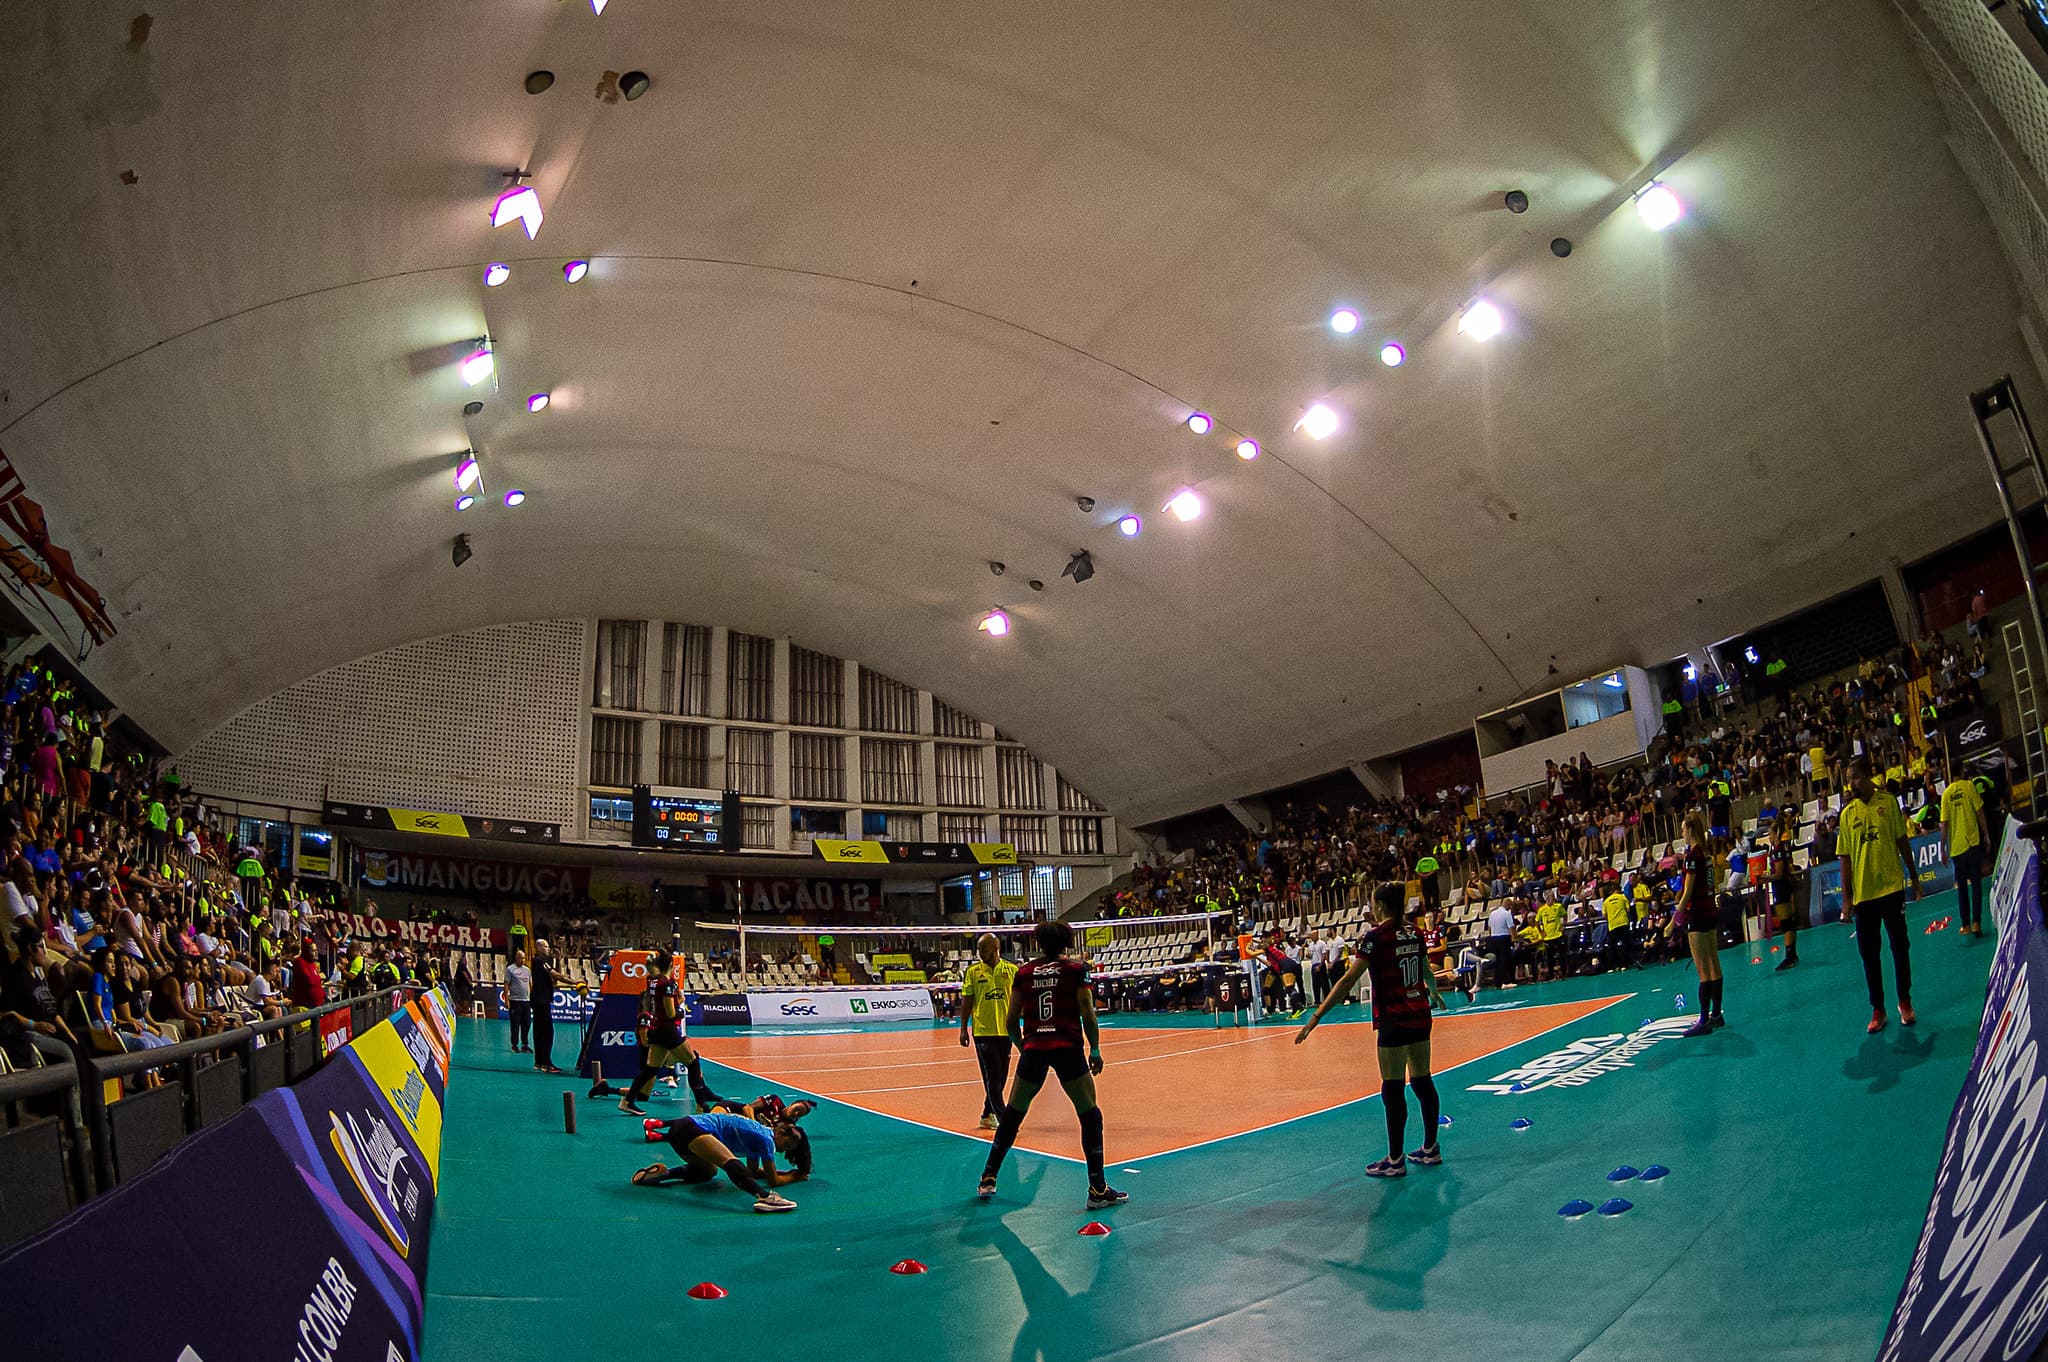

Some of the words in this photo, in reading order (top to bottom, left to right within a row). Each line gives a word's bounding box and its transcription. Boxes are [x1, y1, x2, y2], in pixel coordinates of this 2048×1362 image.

[1959, 719, 1987, 745] Sesc
[415, 814, 440, 829] Sesc
[674, 811, 699, 822] 00:00
[656, 829, 669, 839] 00
[705, 832, 718, 842] 00
[839, 845, 863, 858] Sesc
[992, 848, 1013, 860] Sesc
[721, 878, 835, 913] NAÇÃO
[841, 882, 871, 913] 12
[621, 961, 648, 978] GO
[1032, 962, 1062, 976] Sesc
[1399, 955, 1419, 988] 10
[703, 1004, 748, 1012] RIACHUELO
[780, 998, 819, 1016] Sesc
[1038, 990, 1053, 1022] 6
[601, 1030, 638, 1047] 1XB
